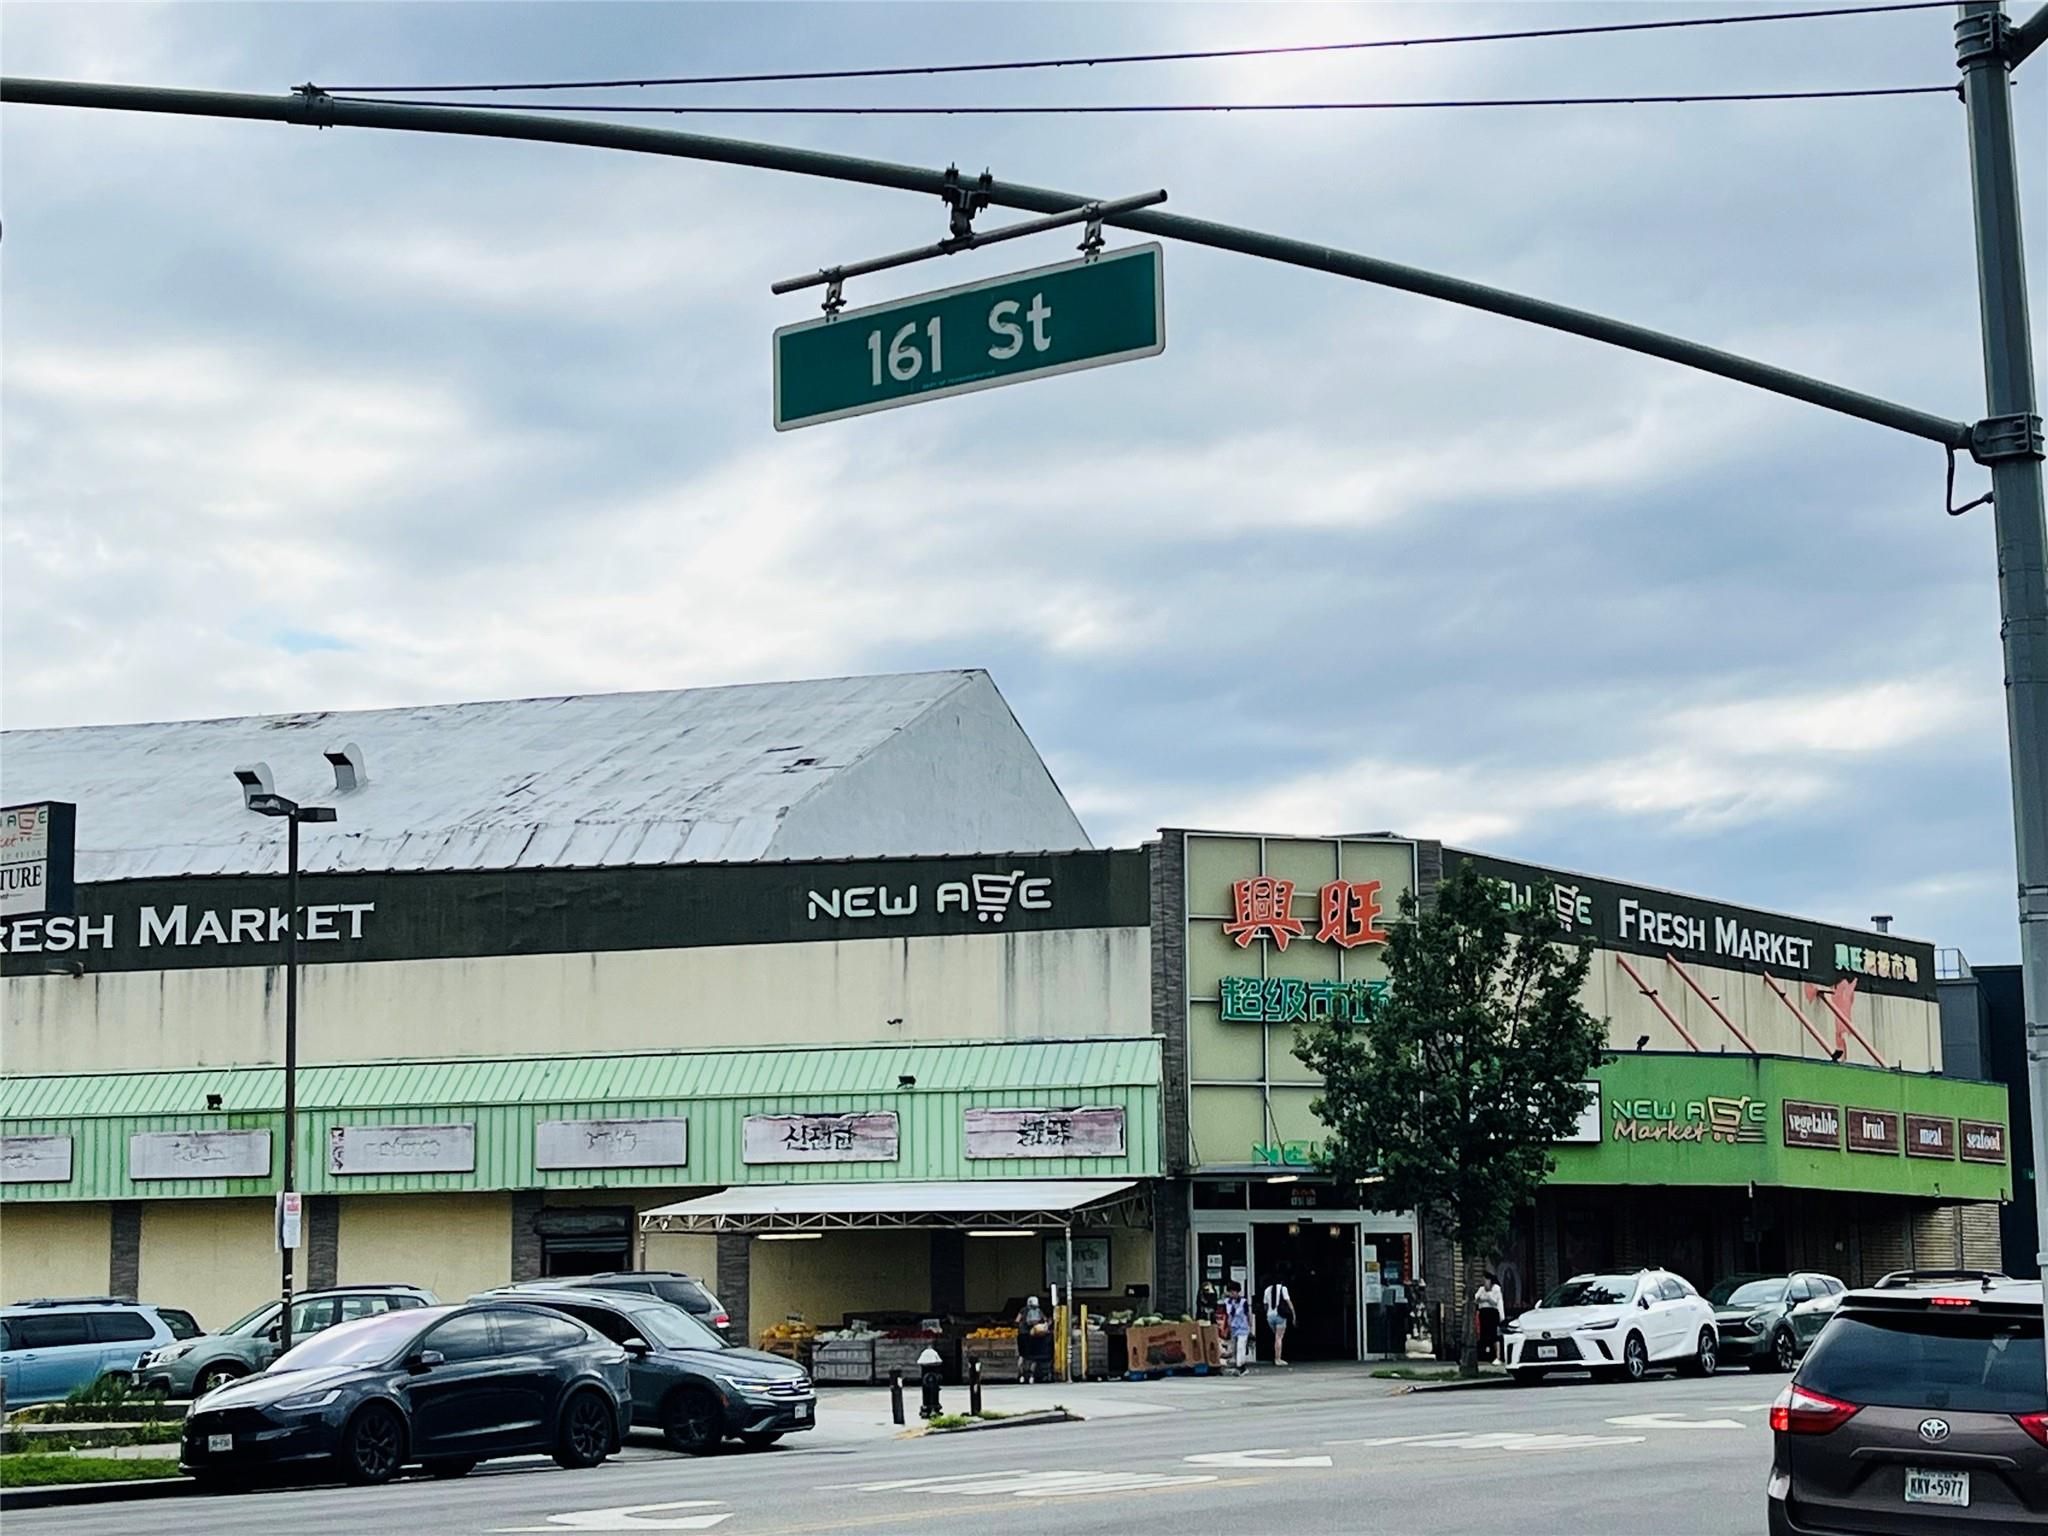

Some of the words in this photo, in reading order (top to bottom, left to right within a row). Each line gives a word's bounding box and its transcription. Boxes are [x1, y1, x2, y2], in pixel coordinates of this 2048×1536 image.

[868, 317, 942, 386] 161
[988, 292, 1052, 360] St
[808, 885, 917, 920] NEW
[937, 870, 1052, 922] AGE
[139, 902, 375, 947] MARKET
[1619, 898, 1706, 951] FRESH
[1715, 916, 1813, 970] MARKET
[1612, 1099, 1676, 1120] NEW
[1687, 1096, 1767, 1142] AGE
[1613, 1120, 1710, 1142] Market
[1789, 1111, 1838, 1139] vegetable
[1862, 1116, 1885, 1140] fruit
[1920, 1127, 1943, 1147] meat
[1966, 1131, 2000, 1151] seafood
